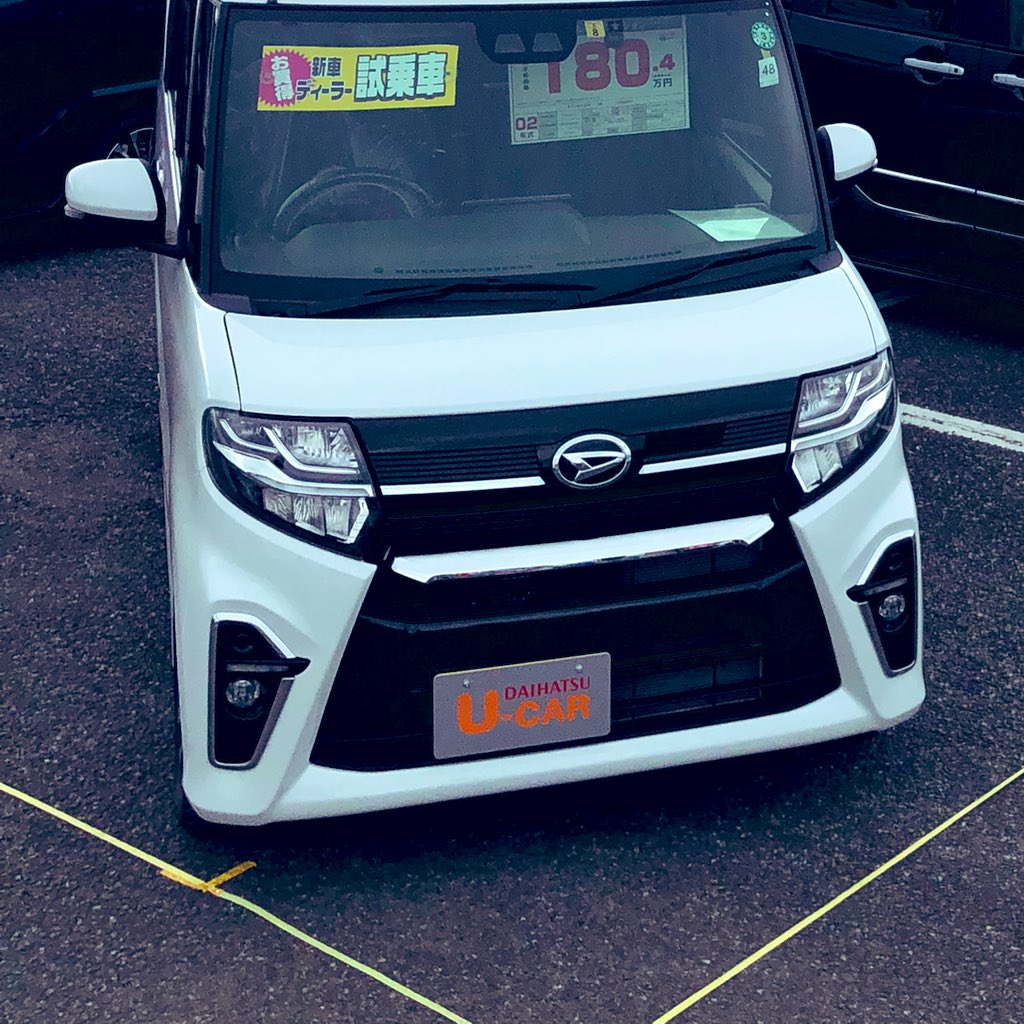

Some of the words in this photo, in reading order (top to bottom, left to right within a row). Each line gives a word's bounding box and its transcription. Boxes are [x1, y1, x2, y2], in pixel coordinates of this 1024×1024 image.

[311, 57, 342, 78] 新車
[354, 51, 448, 102] 試乗車
[761, 63, 776, 76] 48
[296, 78, 352, 102] ディーラー
[652, 77, 673, 89] 万円
[514, 116, 538, 132] 02
[504, 675, 591, 701] DAIHATSU
[456, 689, 591, 736] U-CAR
